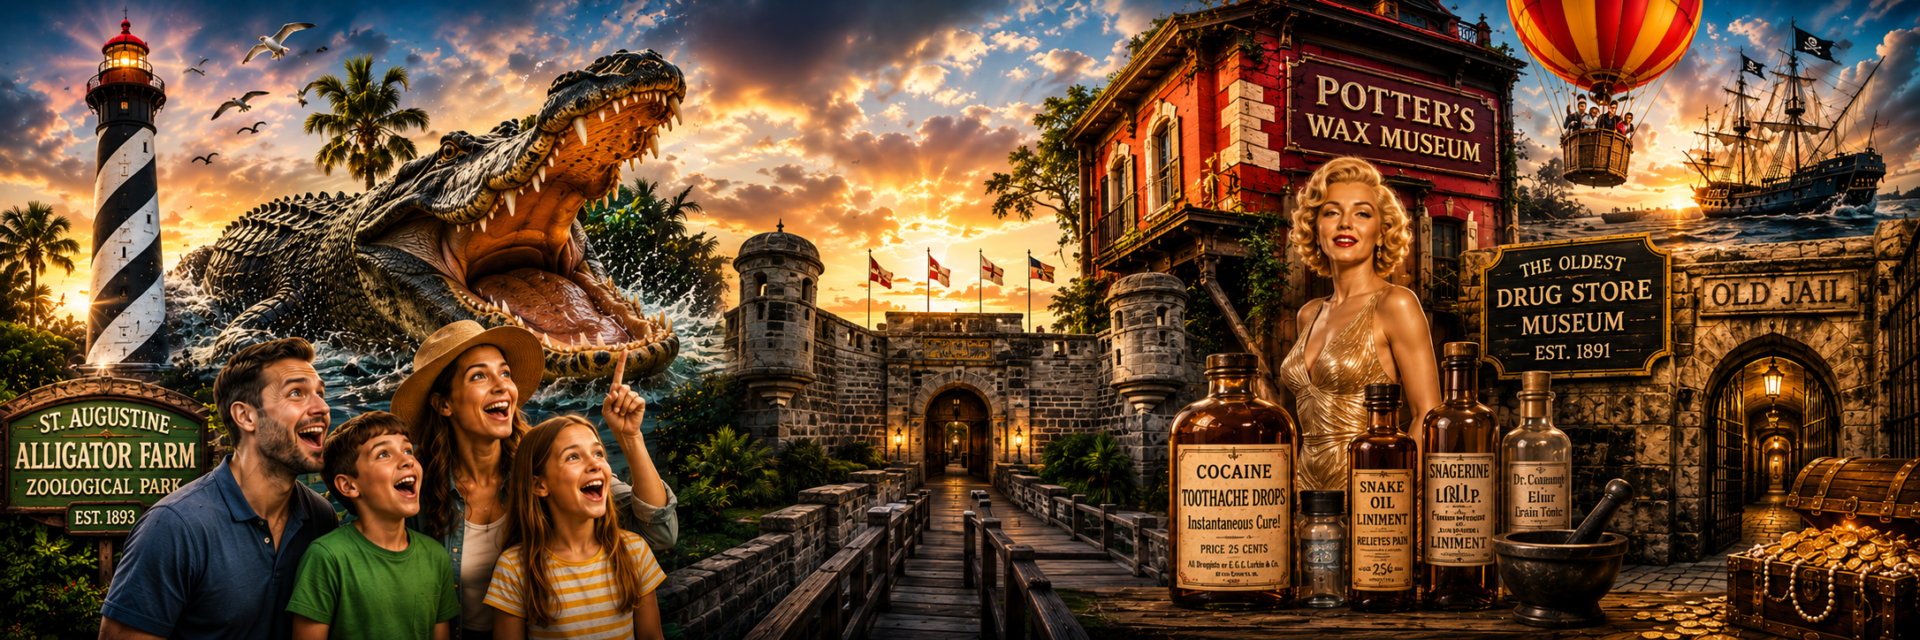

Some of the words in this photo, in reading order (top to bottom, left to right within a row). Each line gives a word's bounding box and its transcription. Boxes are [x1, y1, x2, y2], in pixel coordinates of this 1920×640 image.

[1316, 74, 1476, 133] POTTER'S
[1305, 112, 1372, 145] WAX
[1380, 125, 1481, 163] MUSEUM
[1519, 257, 1552, 278] THE
[1558, 254, 1626, 272] OLDEST
[1496, 284, 1562, 308] DRUG
[1571, 279, 1653, 303] STORE
[1711, 282, 1770, 307] OLD
[1780, 279, 1847, 306] JAIL
[1521, 310, 1625, 336] MUSEUM
[1535, 344, 1571, 361] EST.
[1576, 342, 1611, 359] 1891
[39, 411, 65, 434] ST.
[69, 406, 171, 435] AUGUSTINE
[14, 441, 133, 470] ALLIGATOR
[139, 441, 197, 469] FARM
[1196, 464, 1272, 479] COCAINE
[26, 478, 134, 496] ZOOLOGICAL
[139, 477, 183, 494] PARK
[1360, 481, 1404, 493] SNAKE
[1182, 488, 1249, 507] TOOTHACHE
[1252, 487, 1286, 506] DROPS
[1370, 496, 1395, 509] OIL
[74, 510, 103, 525] EST.
[106, 509, 135, 525] 1893
[1187, 515, 1253, 530] Instantaneous
[1256, 514, 1281, 529] Cure!
[1357, 513, 1408, 526] LINIMENT
[1200, 544, 1225, 554] PRICE
[1228, 544, 1239, 554] 25
[1242, 543, 1268, 554] CENTS
[1392, 536, 1408, 546] PAIN
[1431, 536, 1487, 549] LINIMENT
